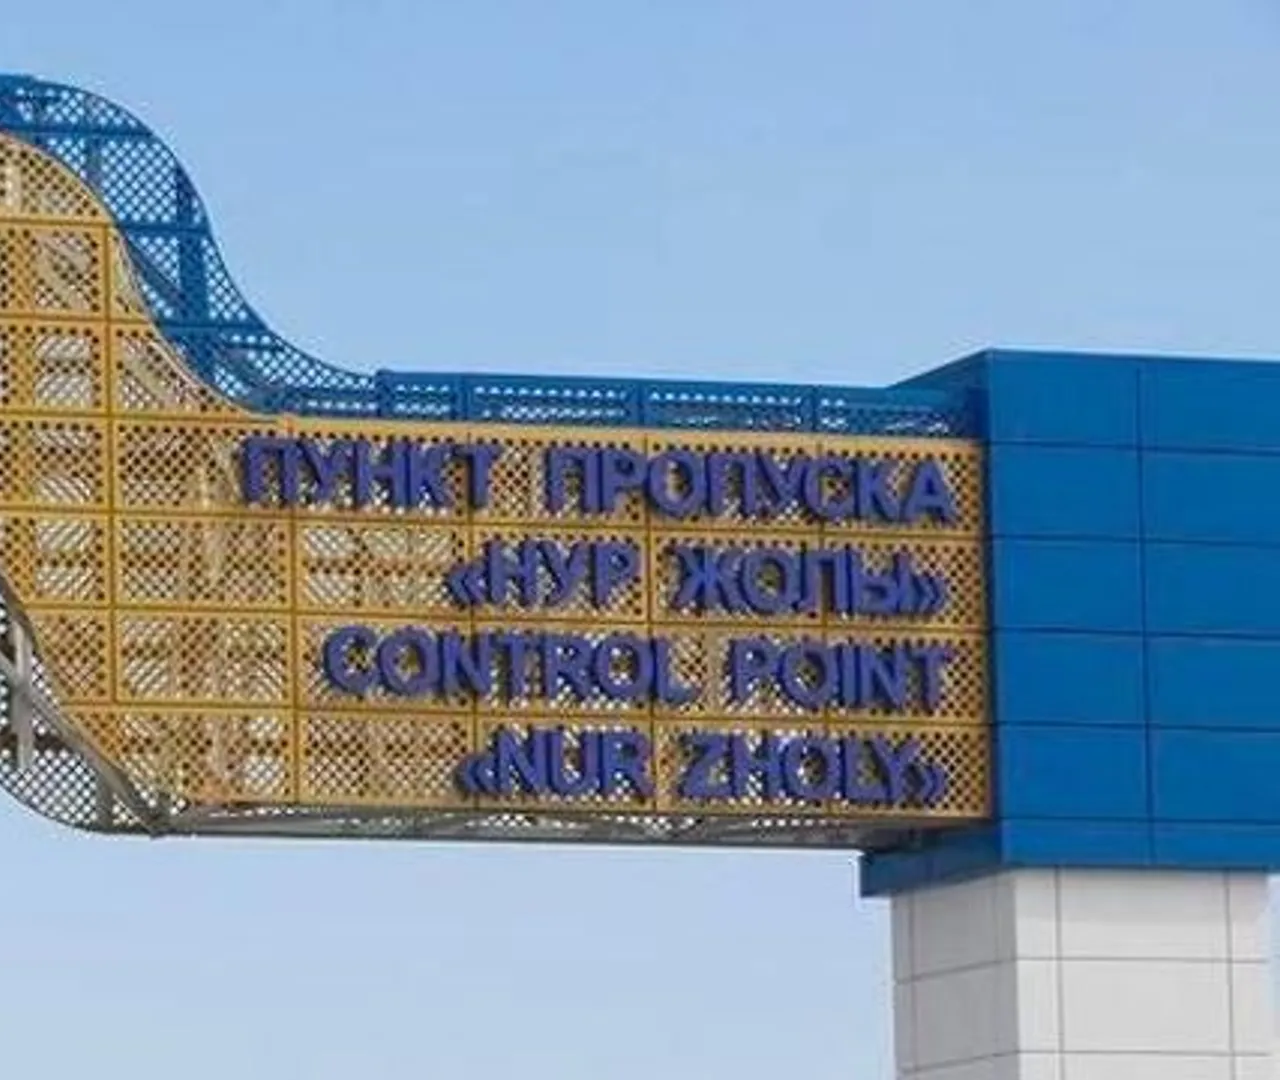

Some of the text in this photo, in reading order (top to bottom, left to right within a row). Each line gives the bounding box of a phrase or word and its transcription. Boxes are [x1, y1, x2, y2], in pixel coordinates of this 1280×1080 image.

[240, 436, 955, 524] ПУНКТ ПРОПУСКА
[446, 538, 640, 610] «НУР
[323, 626, 952, 711] CONTROL POINT
[454, 726, 946, 806] «NUR ZHOLY»
